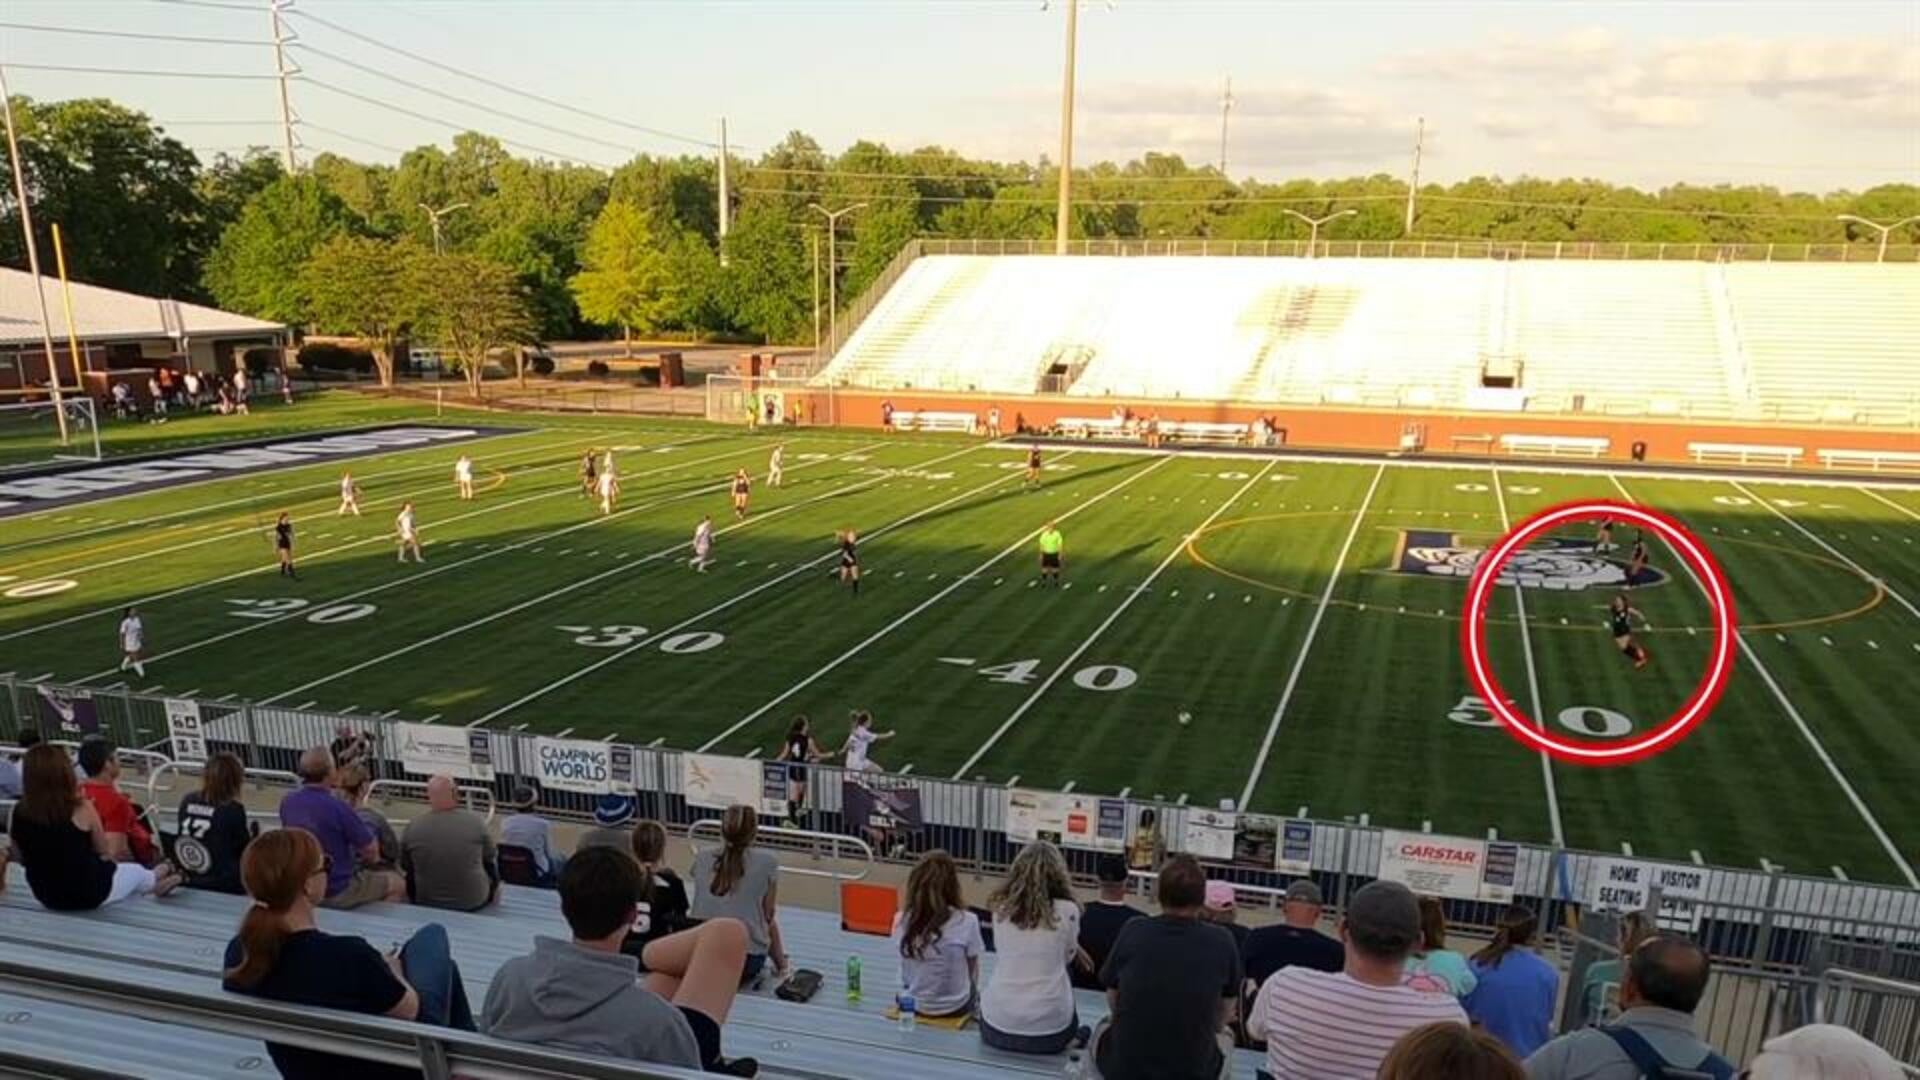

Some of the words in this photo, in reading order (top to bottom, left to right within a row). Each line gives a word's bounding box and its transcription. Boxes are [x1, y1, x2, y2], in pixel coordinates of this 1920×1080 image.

[540, 745, 607, 766] CAMPING
[542, 758, 607, 782] WORLD
[182, 816, 211, 837] 17
[1400, 844, 1477, 863] CARSTAR
[1609, 865, 1640, 883] HOME
[1660, 869, 1701, 889] VISITOR
[1598, 885, 1643, 907] SEATING
